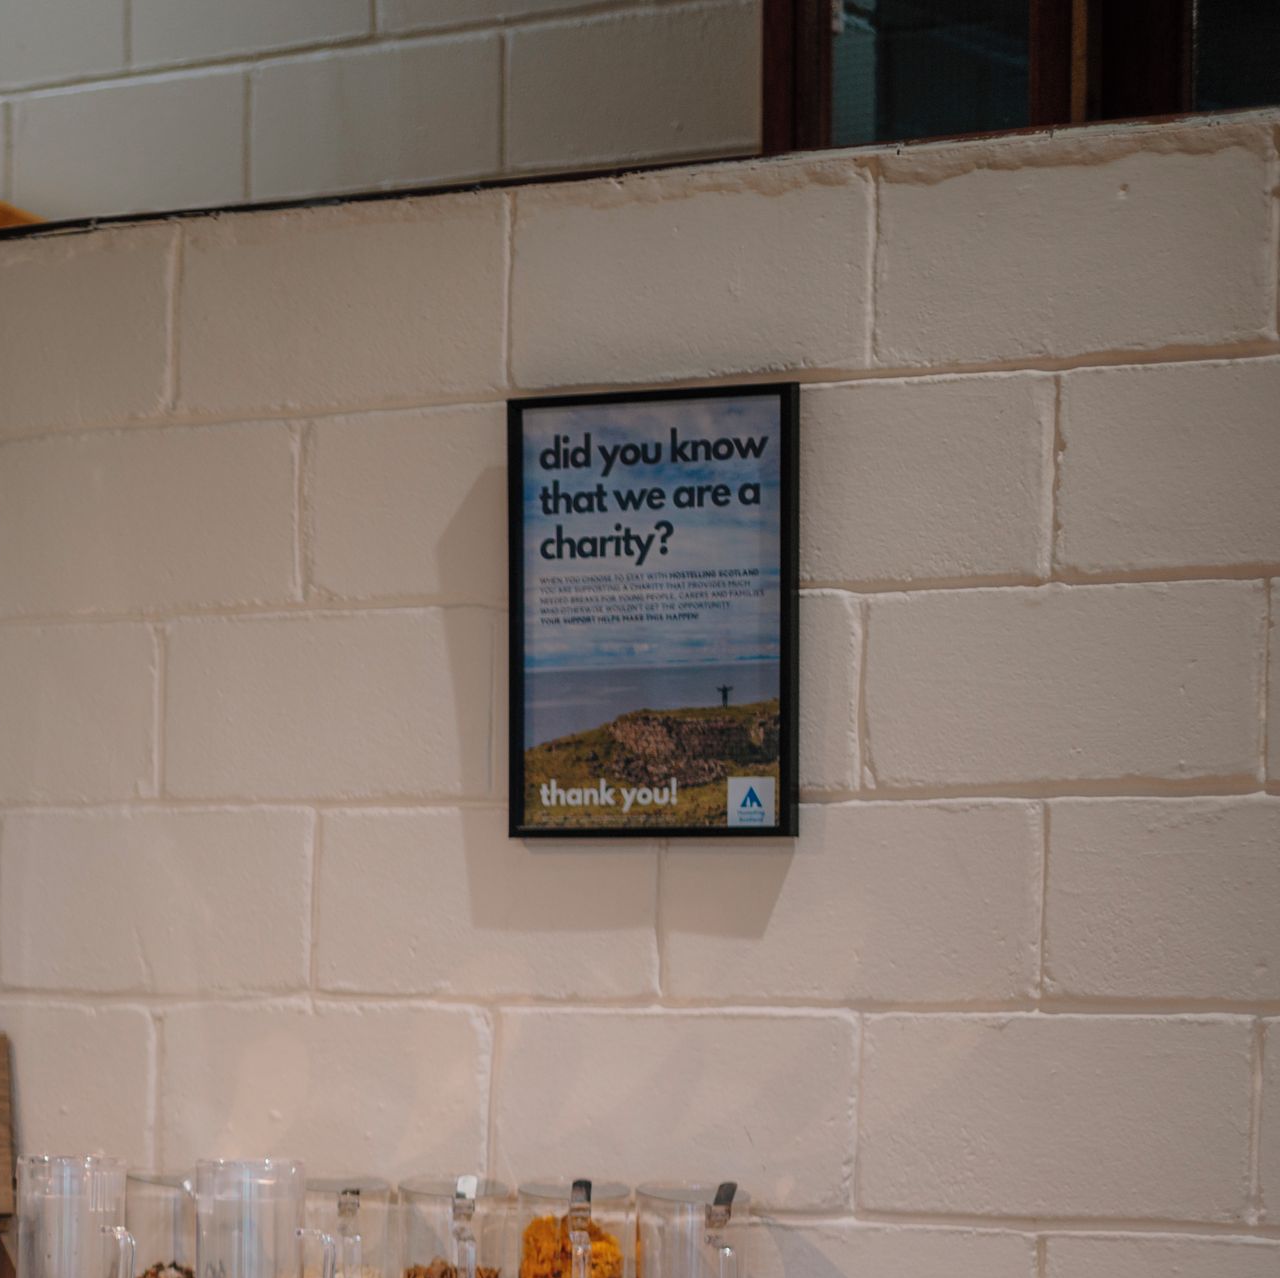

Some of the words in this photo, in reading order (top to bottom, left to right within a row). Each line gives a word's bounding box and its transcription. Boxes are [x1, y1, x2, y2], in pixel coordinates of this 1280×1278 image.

[539, 432, 591, 470] did
[597, 441, 662, 477] you
[670, 427, 769, 463] know
[539, 480, 608, 515] that
[613, 487, 666, 511] we
[673, 483, 731, 509] are
[738, 482, 761, 506] a
[539, 520, 675, 566] charity?
[669, 569, 716, 579] HOSTELLING
[718, 568, 759, 576] SCOTLAND
[539, 778, 616, 806] thank
[620, 777, 678, 813] you!
